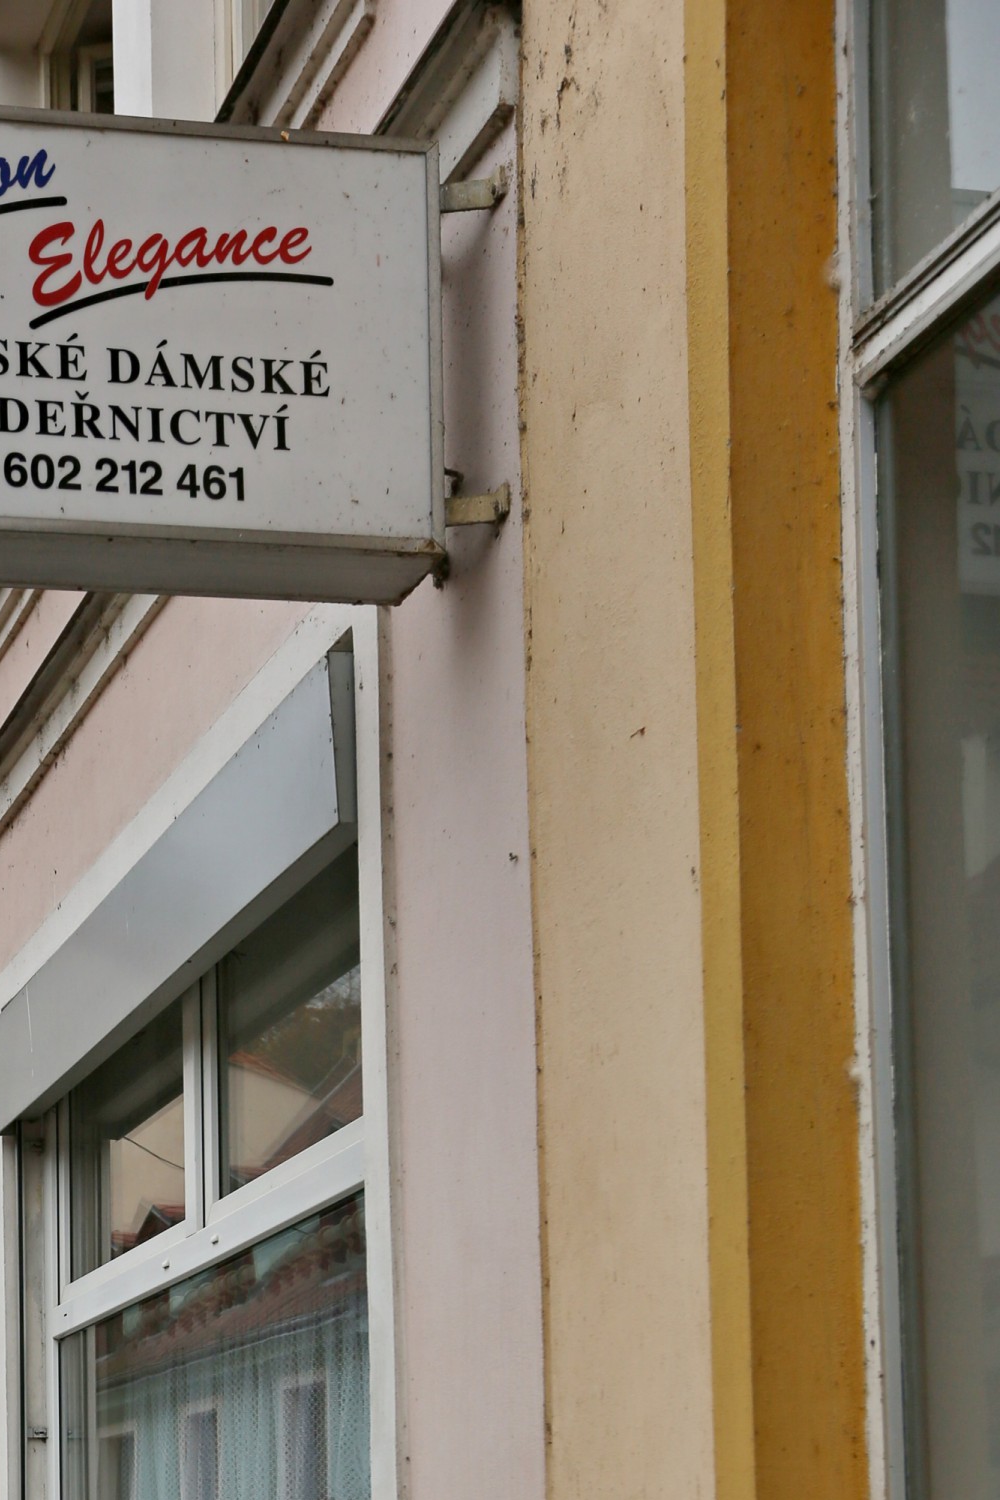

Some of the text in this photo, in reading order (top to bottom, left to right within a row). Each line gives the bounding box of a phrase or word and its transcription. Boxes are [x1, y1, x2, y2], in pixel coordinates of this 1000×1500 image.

[28, 218, 313, 307] Elegance
[106, 338, 332, 399] DÁMSKÉ
[2, 450, 83, 491] 602
[94, 456, 165, 497] 212
[176, 462, 246, 503] 461
